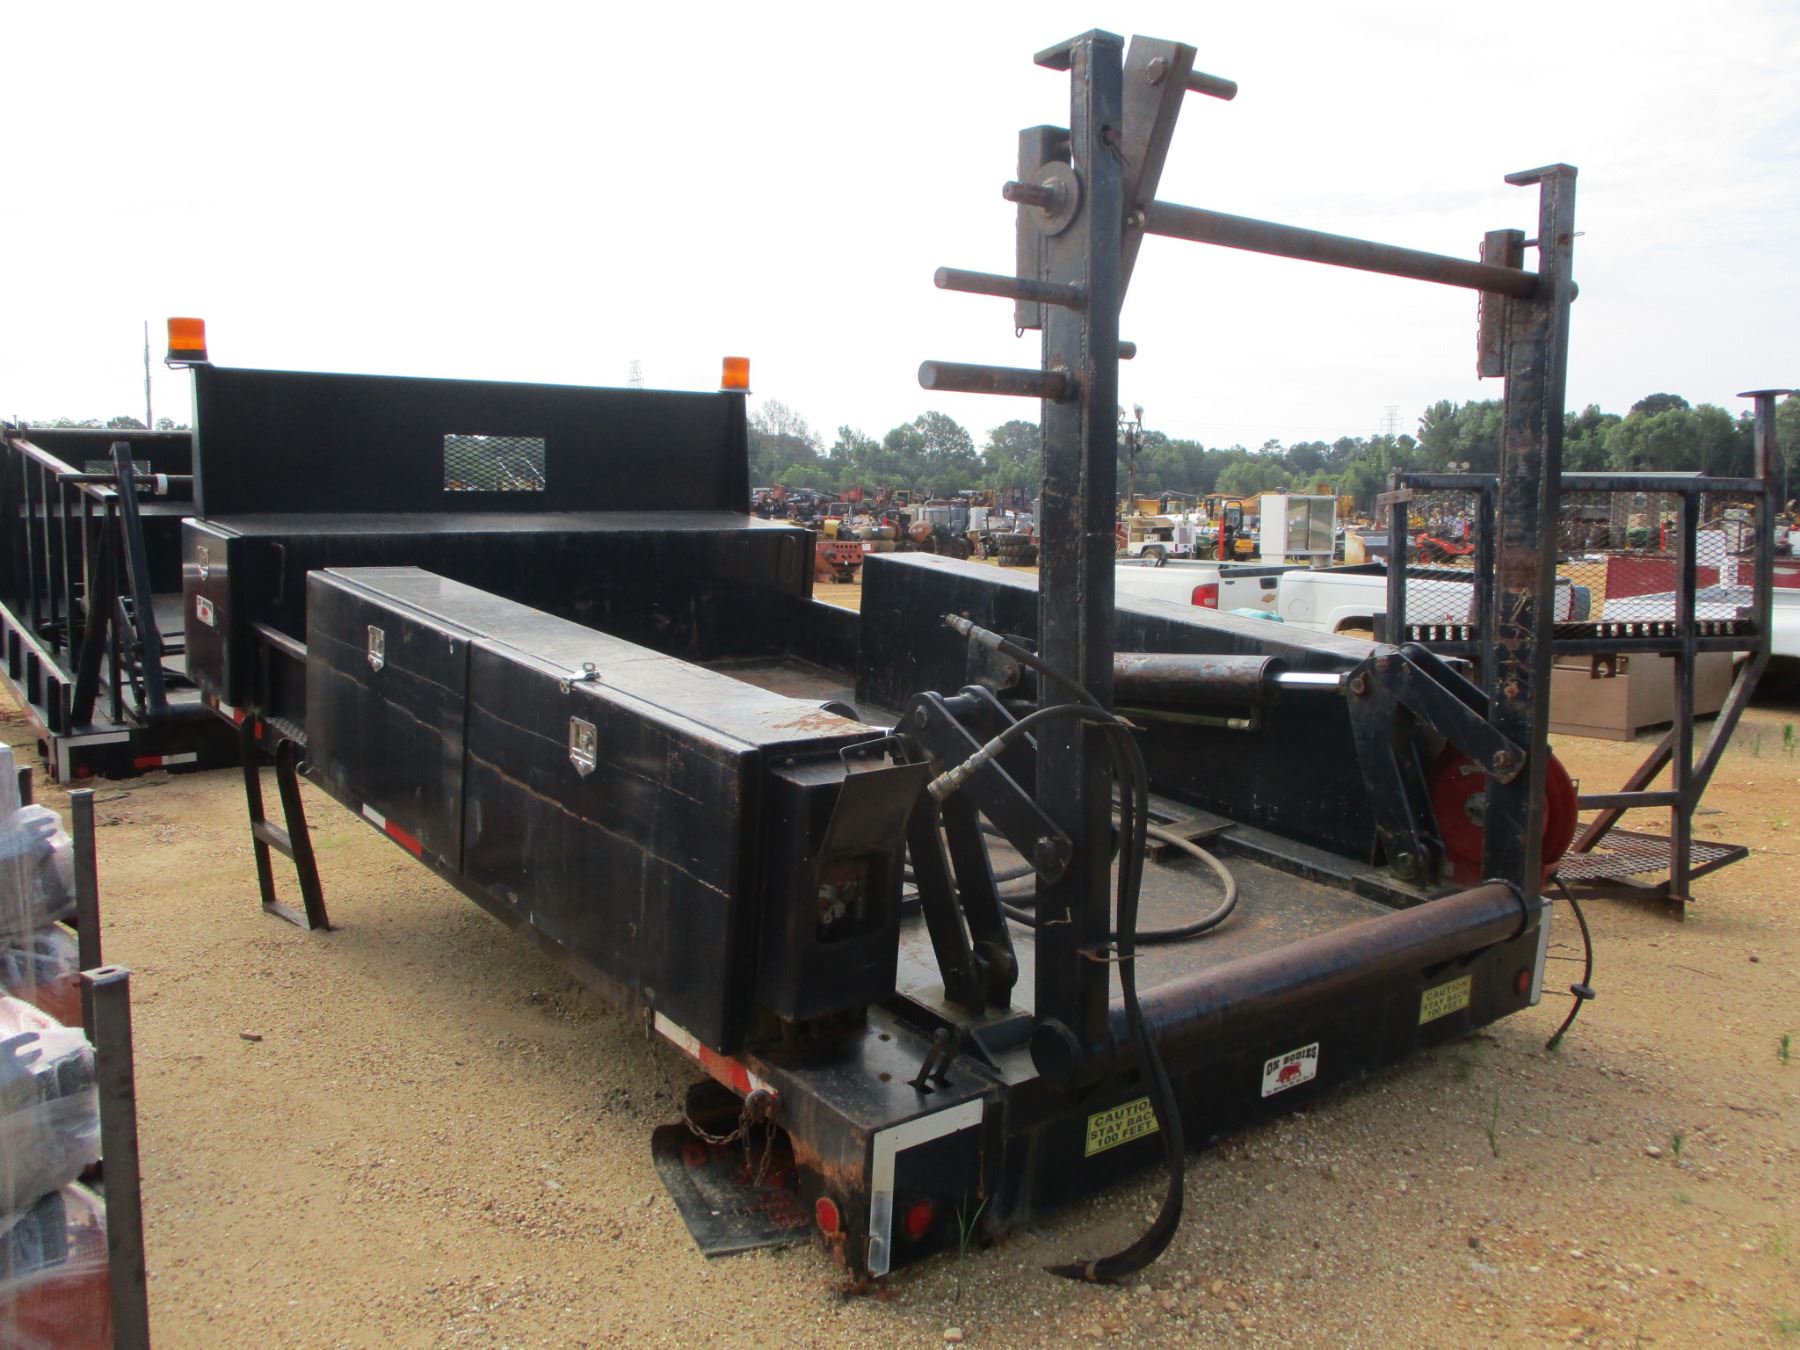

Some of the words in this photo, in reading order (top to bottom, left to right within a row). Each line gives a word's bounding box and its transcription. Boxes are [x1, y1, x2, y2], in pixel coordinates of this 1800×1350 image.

[1426, 981, 1467, 1000] CAUTION
[1266, 1059, 1280, 1076] OX
[1283, 1046, 1317, 1065] BODIES
[1090, 1121, 1122, 1140] STAY
[1127, 1111, 1153, 1127] BAC
[1095, 1101, 1149, 1127] CAUTIO
[1097, 1133, 1119, 1147] 100
[1122, 1121, 1153, 1138] FEET
